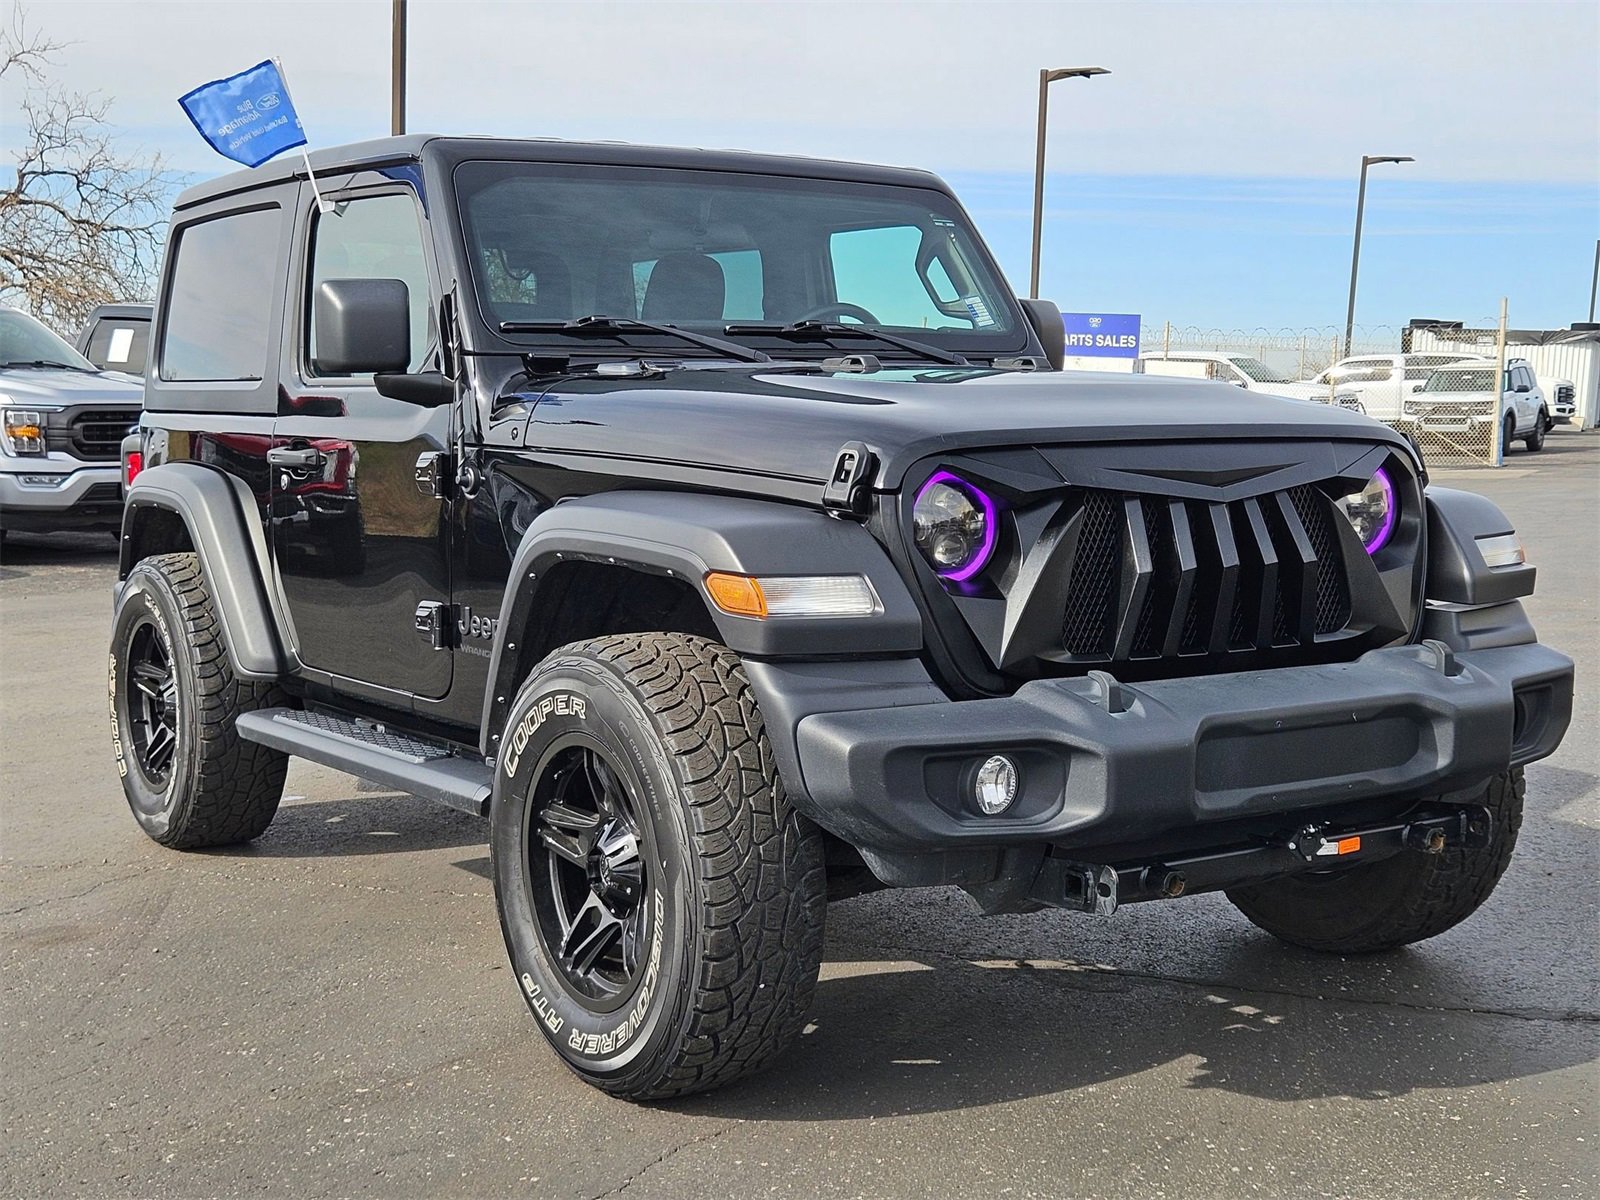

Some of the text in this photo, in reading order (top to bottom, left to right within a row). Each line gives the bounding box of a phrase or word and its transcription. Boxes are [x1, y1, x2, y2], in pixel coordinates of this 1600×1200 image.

[1065, 334, 1136, 348] ARTS SALES
[460, 643, 492, 658] WRANG
[108, 652, 128, 779] COOPER
[504, 694, 587, 779] COOPER
[568, 888, 665, 1056] DISCOVERER
